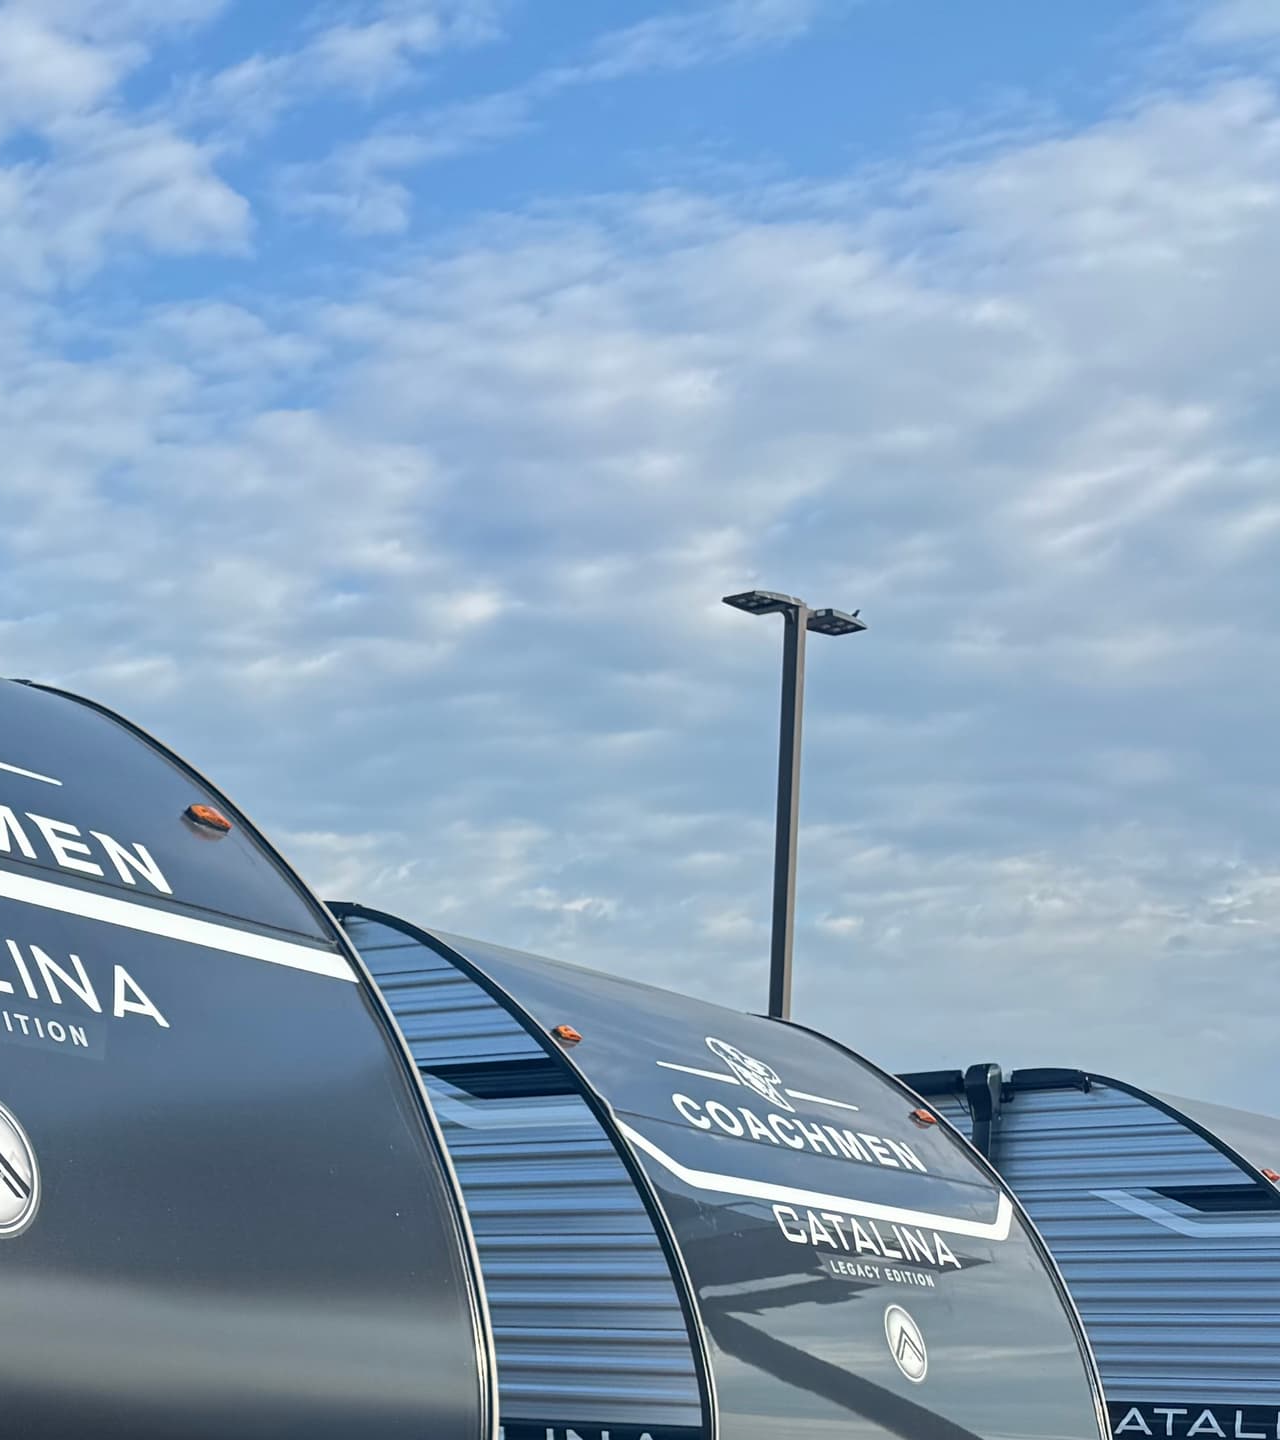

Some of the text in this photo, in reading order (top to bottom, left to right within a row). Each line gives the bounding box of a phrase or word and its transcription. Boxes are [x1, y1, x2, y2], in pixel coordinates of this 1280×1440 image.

[671, 1092, 928, 1173] COACHMEN
[771, 1203, 962, 1270] CATALINA
[829, 1259, 935, 1288] LEGACY EDITION
